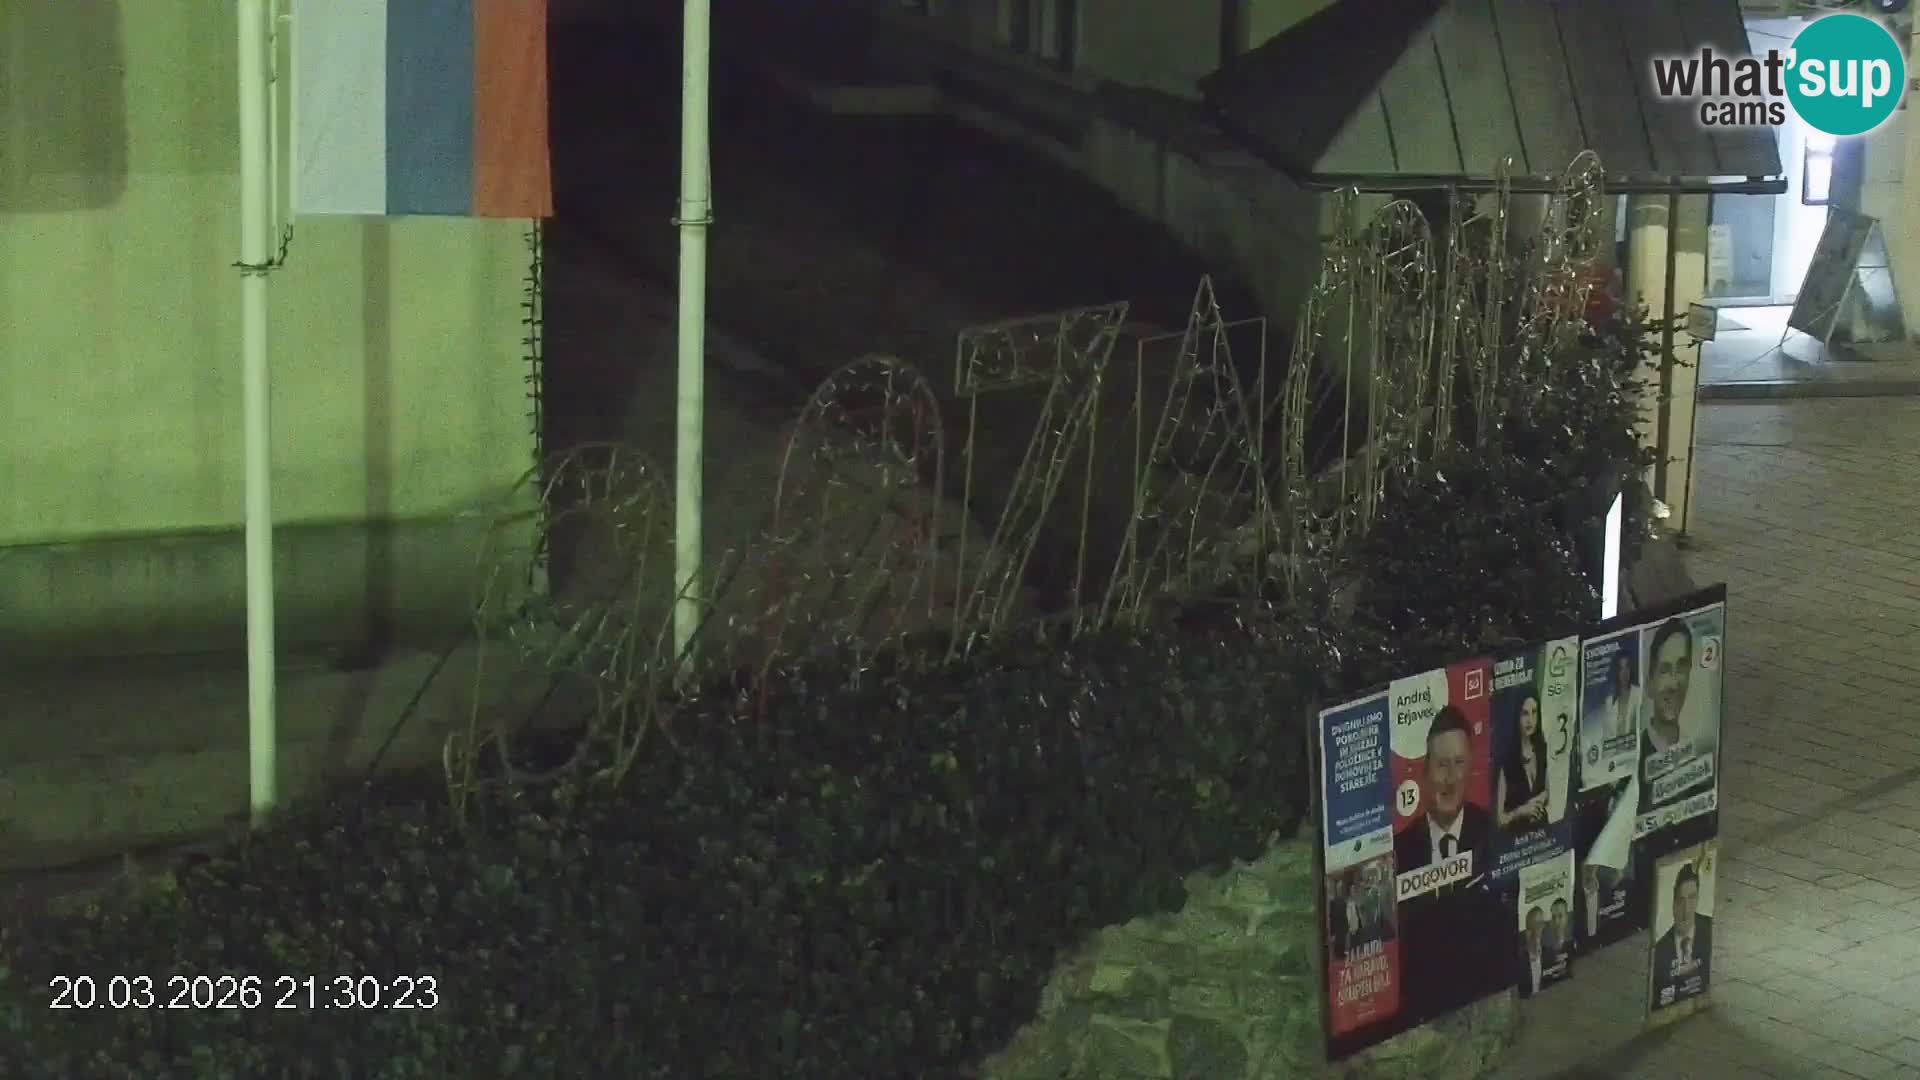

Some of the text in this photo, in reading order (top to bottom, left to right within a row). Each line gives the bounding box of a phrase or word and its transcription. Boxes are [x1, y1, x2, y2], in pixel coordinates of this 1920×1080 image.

[1397, 685, 1432, 707] Andrej
[1397, 707, 1434, 726] Erjavec
[1401, 788, 1416, 806] 13
[1401, 857, 1469, 895] DOGOVOR
